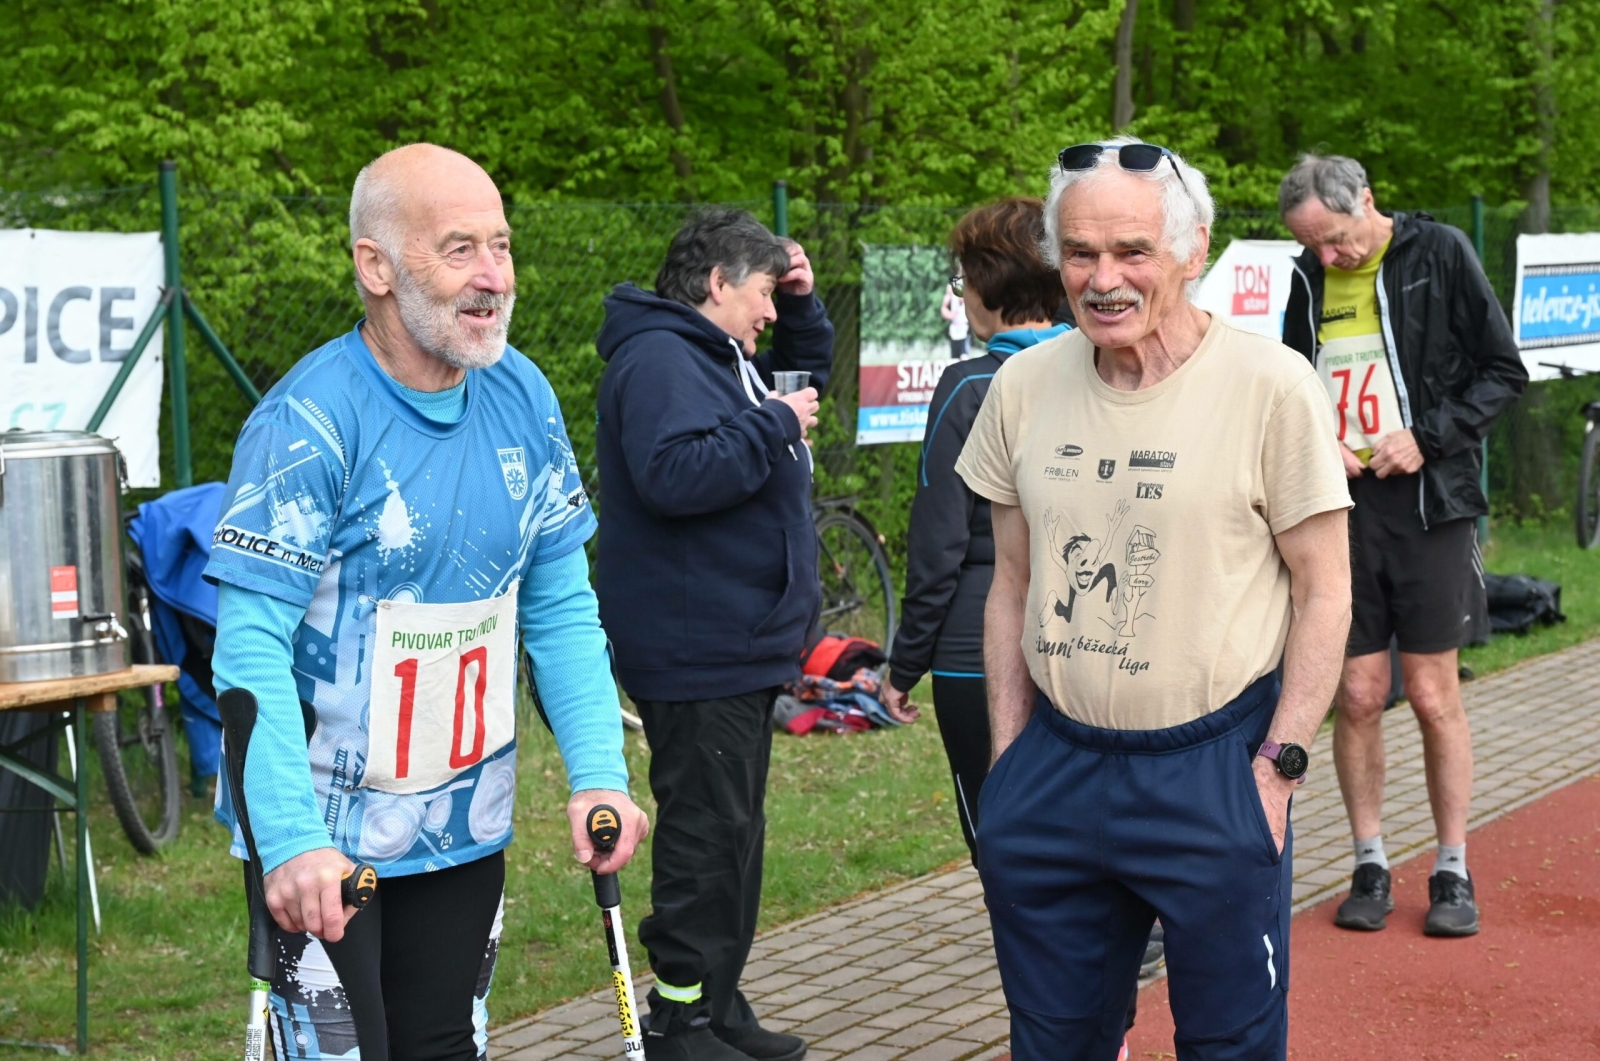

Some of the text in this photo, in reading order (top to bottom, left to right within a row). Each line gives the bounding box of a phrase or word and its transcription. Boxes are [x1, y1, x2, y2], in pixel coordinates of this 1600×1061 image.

[1331, 363, 1380, 441] 76
[1130, 450, 1177, 461] MARATON
[1043, 466, 1079, 478] FROLEN
[1135, 485, 1163, 499] LES
[391, 631, 453, 650] PIVOVAR
[1077, 635, 1130, 656] běžecká
[1118, 656, 1151, 676] liga
[394, 646, 487, 779] 10
